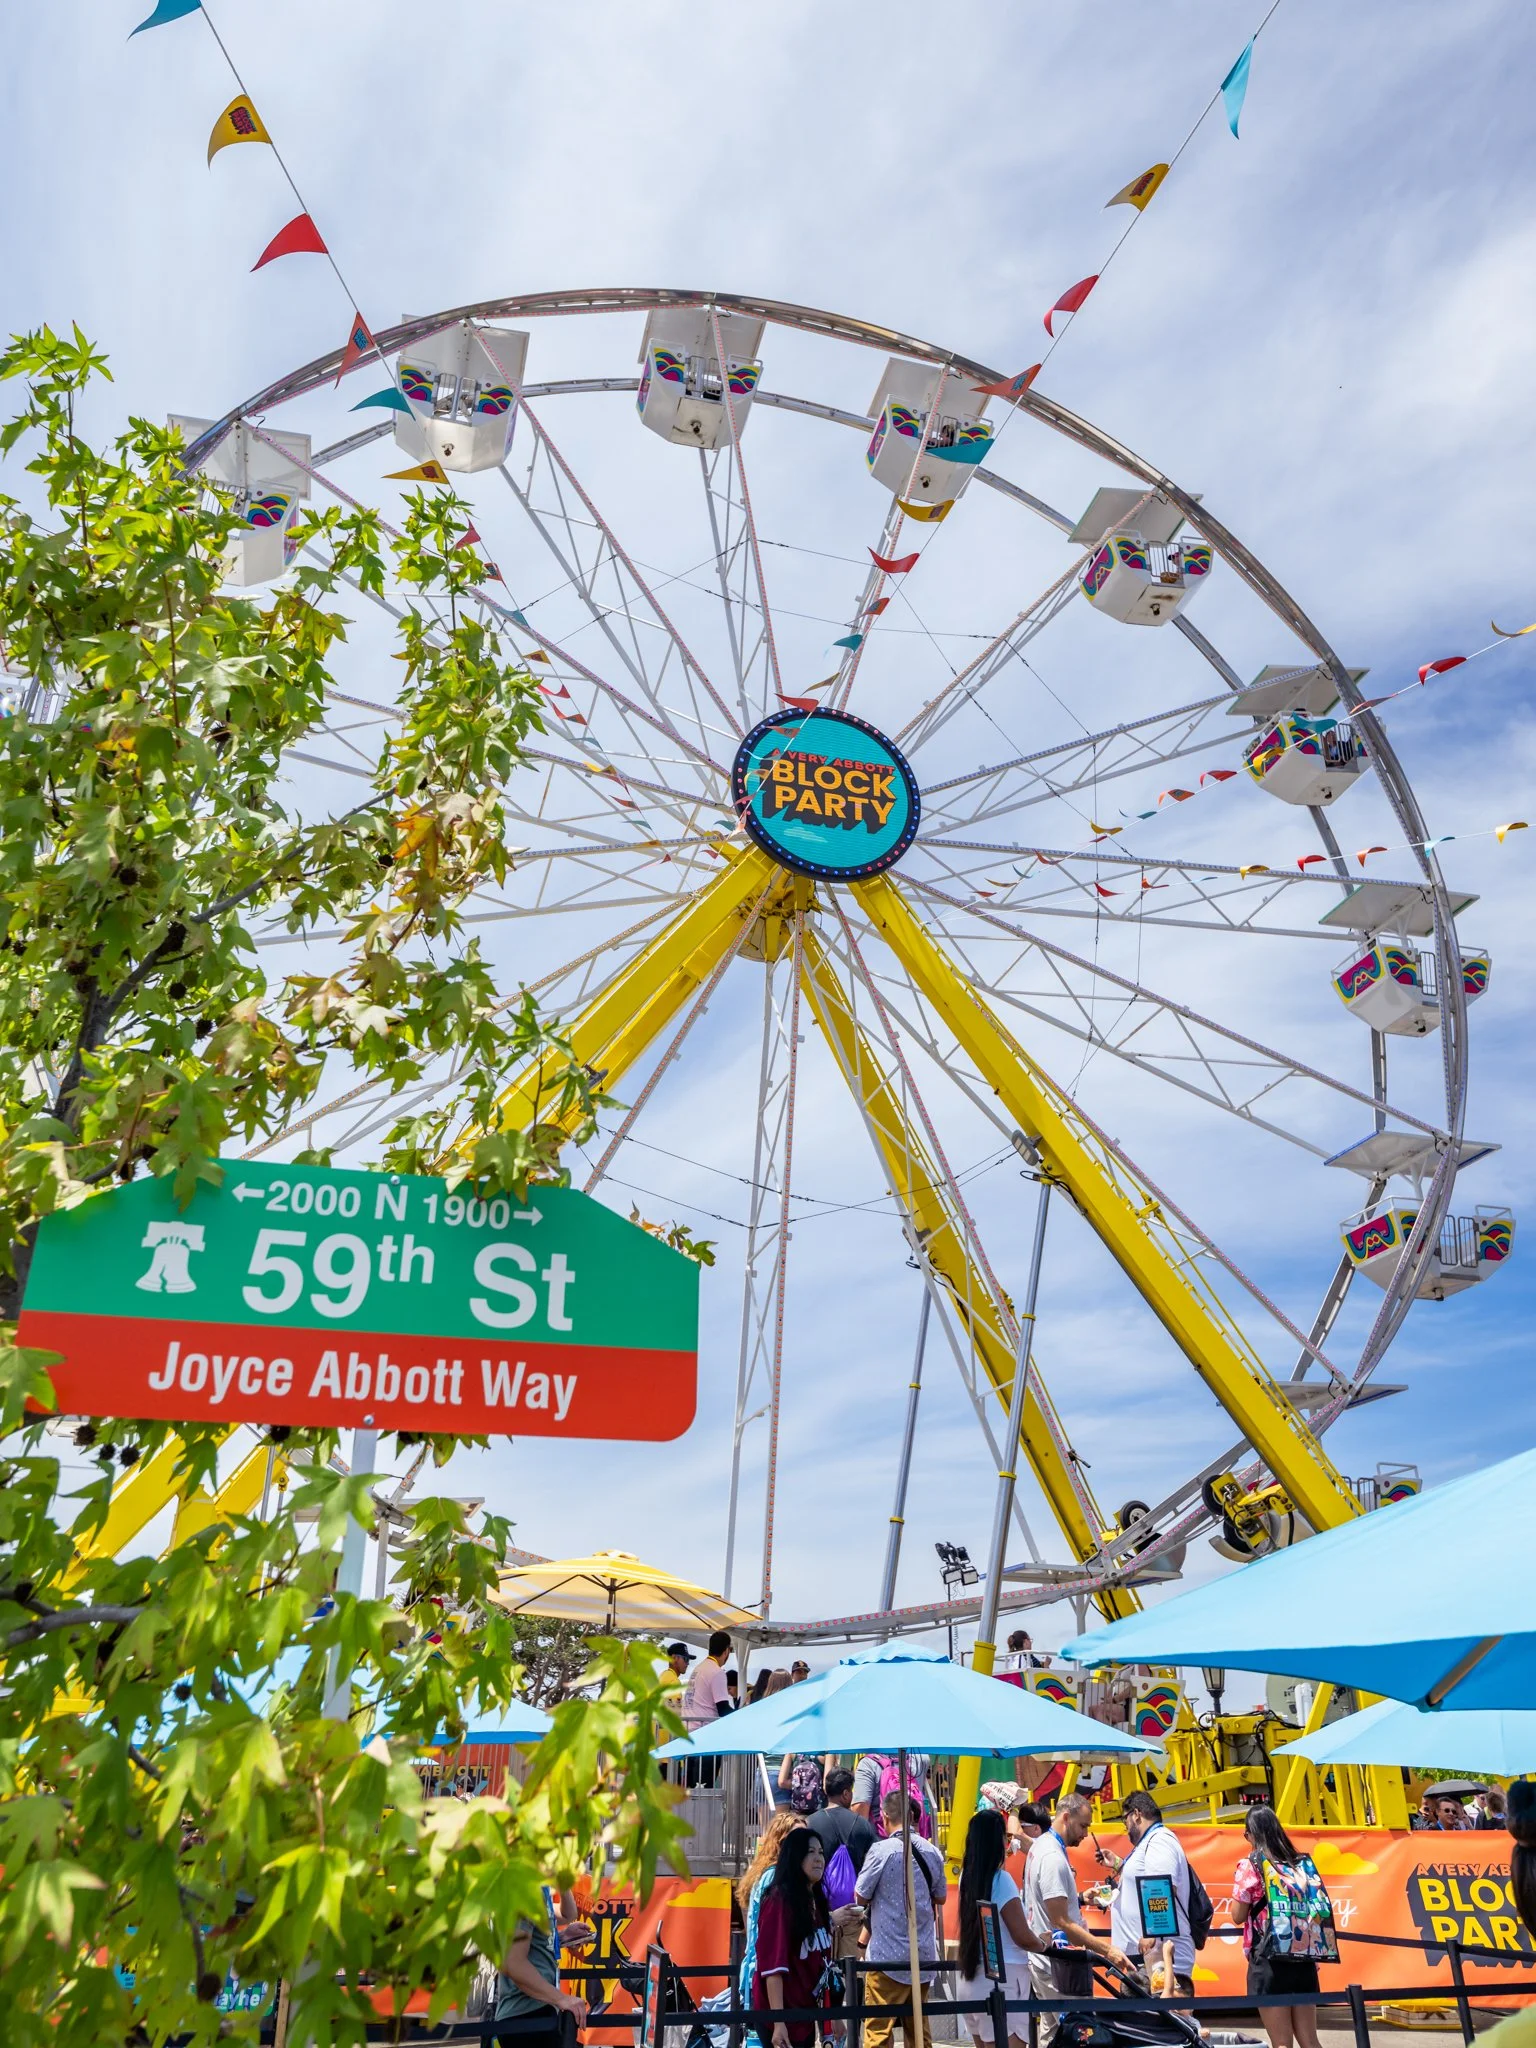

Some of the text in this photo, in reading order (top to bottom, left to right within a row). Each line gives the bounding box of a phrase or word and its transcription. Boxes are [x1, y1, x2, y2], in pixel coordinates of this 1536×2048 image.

[772, 759, 897, 799] BLOCK
[788, 750, 828, 764] VERY
[833, 758, 895, 774] ABBOTT
[775, 786, 895, 824] PARTY
[265, 1180, 510, 1230] 2000 N 1900
[242, 1229, 576, 1332] 59th St
[148, 1341, 577, 1421] Joyce Abbott Way
[1431, 1864, 1481, 1878] VERY
